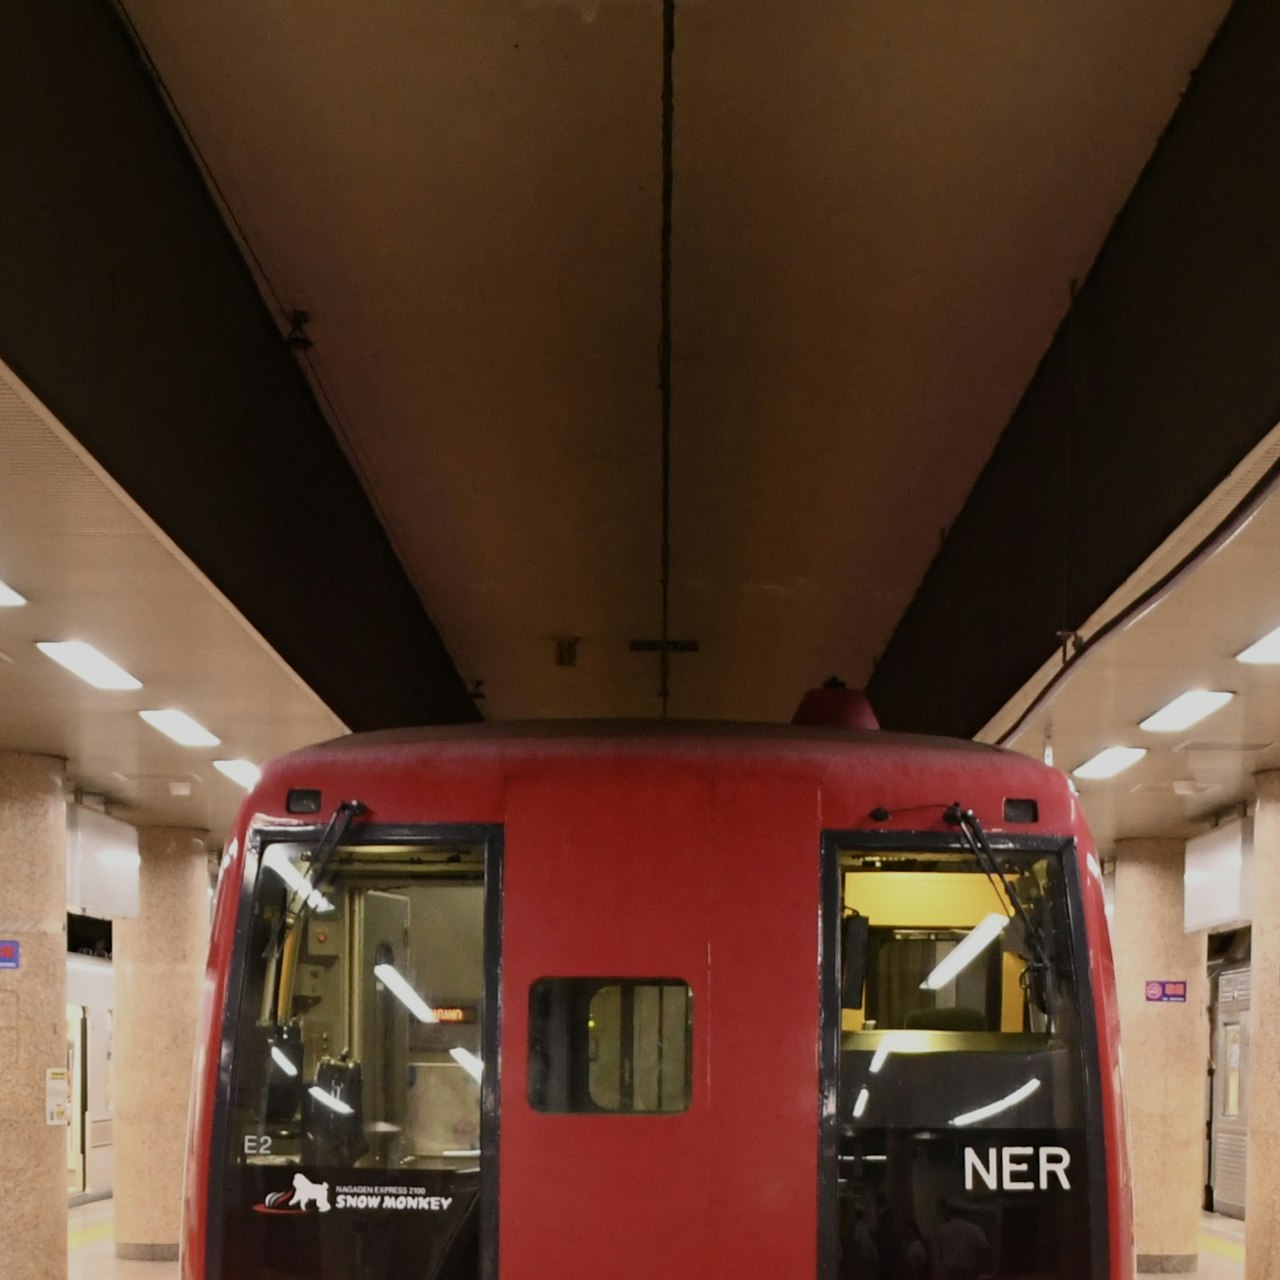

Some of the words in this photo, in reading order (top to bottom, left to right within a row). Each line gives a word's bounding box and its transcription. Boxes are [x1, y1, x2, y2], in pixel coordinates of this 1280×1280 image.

[244, 1135, 272, 1154] E2
[964, 1146, 1071, 1190] NER
[336, 1185, 374, 1194] NAGADEN
[375, 1186, 408, 1195] EXPRESS
[409, 1187, 426, 1195] 2100
[335, 1195, 381, 1209] SNOW
[382, 1195, 453, 1211] MONKEY
